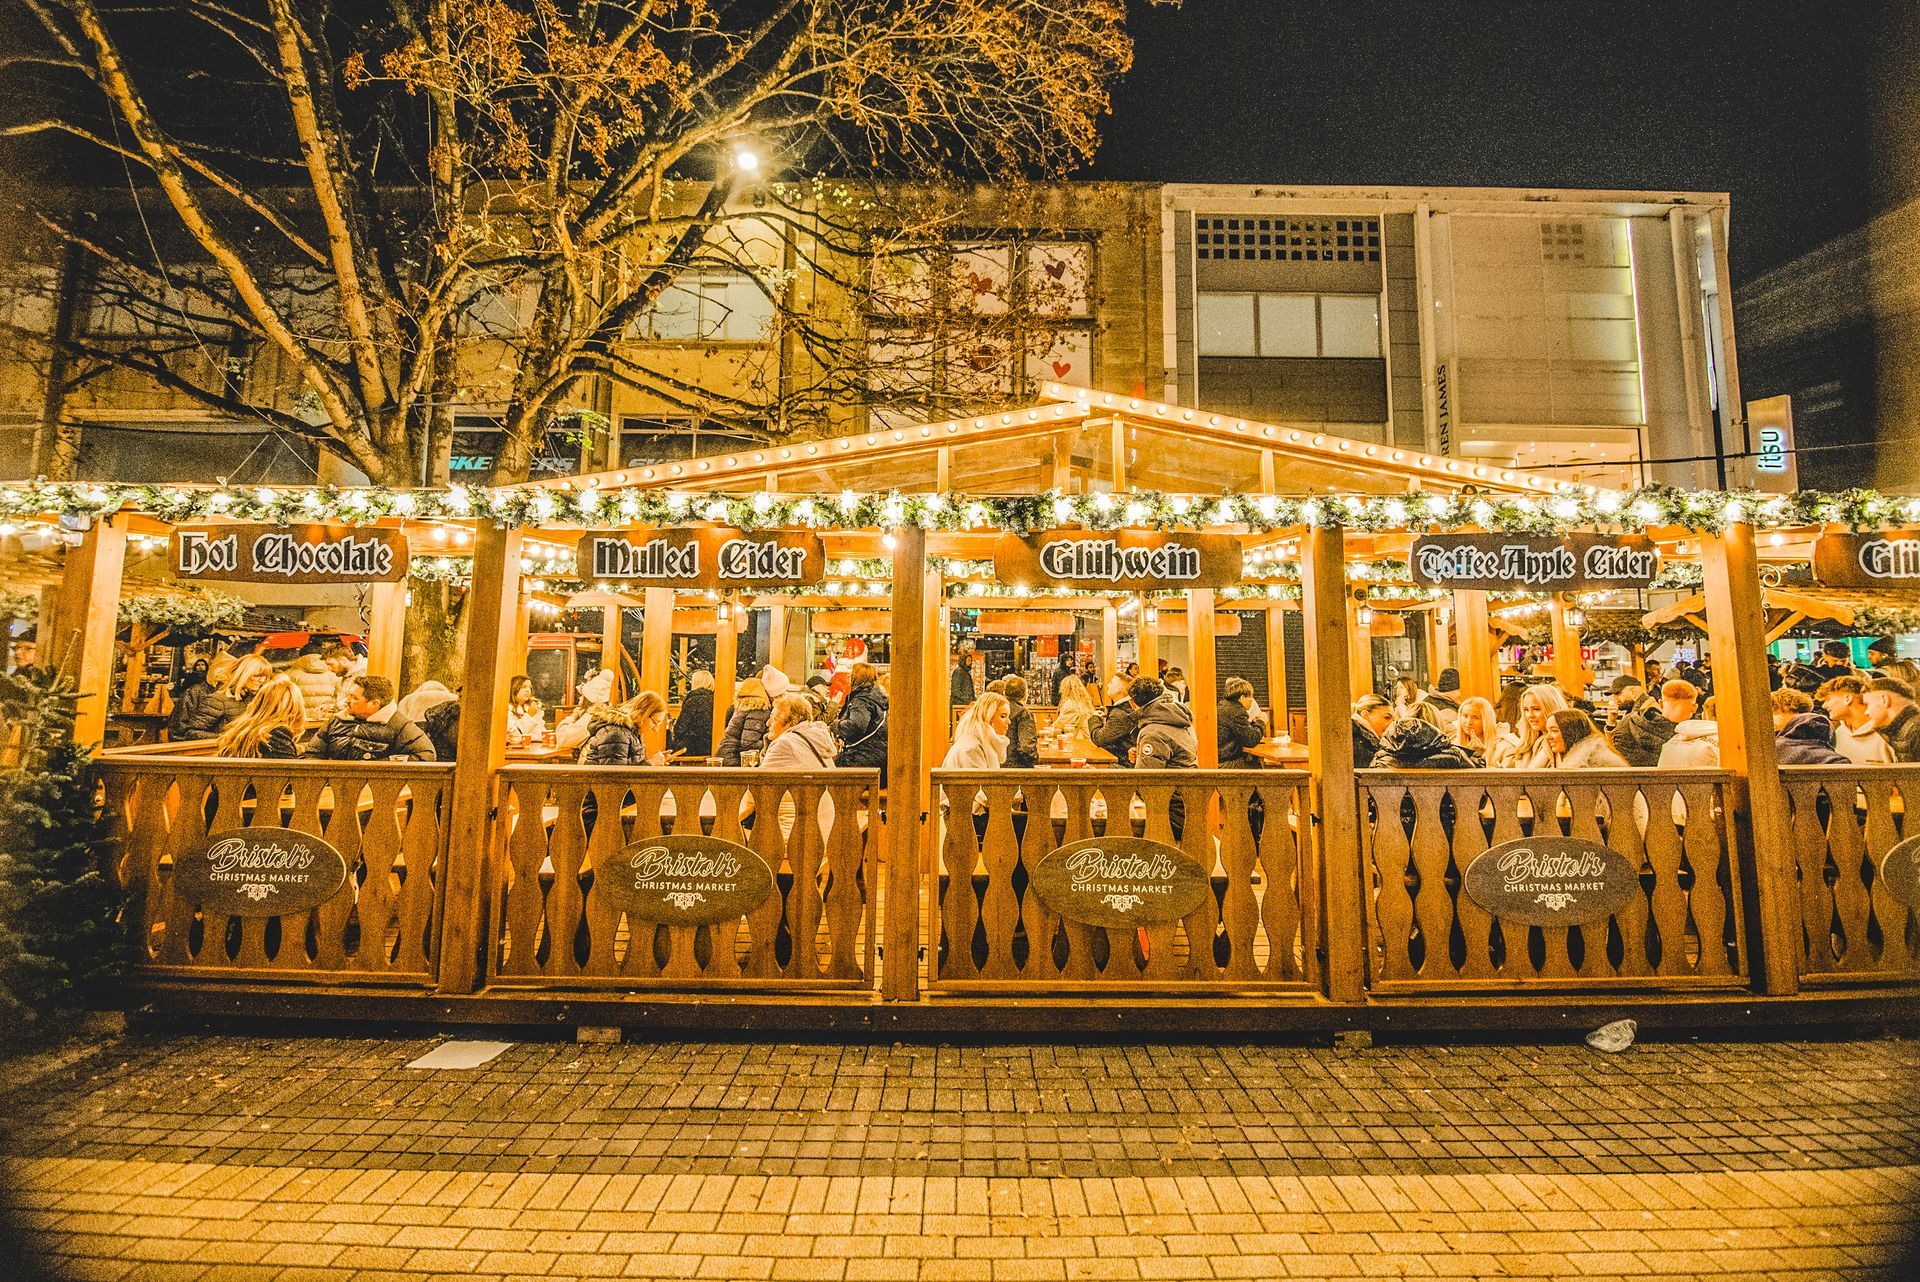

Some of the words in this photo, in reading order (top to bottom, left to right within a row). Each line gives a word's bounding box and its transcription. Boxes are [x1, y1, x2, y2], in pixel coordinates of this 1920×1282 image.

[1437, 364, 1448, 418] JAMES
[1440, 422, 1450, 458] REN
[1757, 431, 1782, 468] itsu
[178, 531, 237, 574] Hot
[252, 533, 393, 577] Chocolate
[593, 538, 700, 579] Mulled
[717, 539, 807, 579] Cider
[1040, 539, 1201, 583] Glühwein
[1416, 544, 1500, 583] Toffee
[1500, 545, 1576, 584] Apple
[1584, 545, 1654, 579] Cider
[207, 838, 315, 873] Bristol's
[631, 846, 742, 881] Bristol's
[1065, 848, 1177, 884] Bristol's
[1497, 849, 1606, 884] Bristol's
[210, 872, 266, 882] CHRISTMAS
[269, 873, 310, 883] MARKET
[634, 881, 692, 891] CHRISTMAS
[696, 882, 737, 892] MARKET
[1071, 883, 1129, 893] CHRISTMAS
[1132, 885, 1173, 894] MARKET
[1504, 883, 1561, 893] CHRISTMAS
[1564, 882, 1605, 891] MARKET
